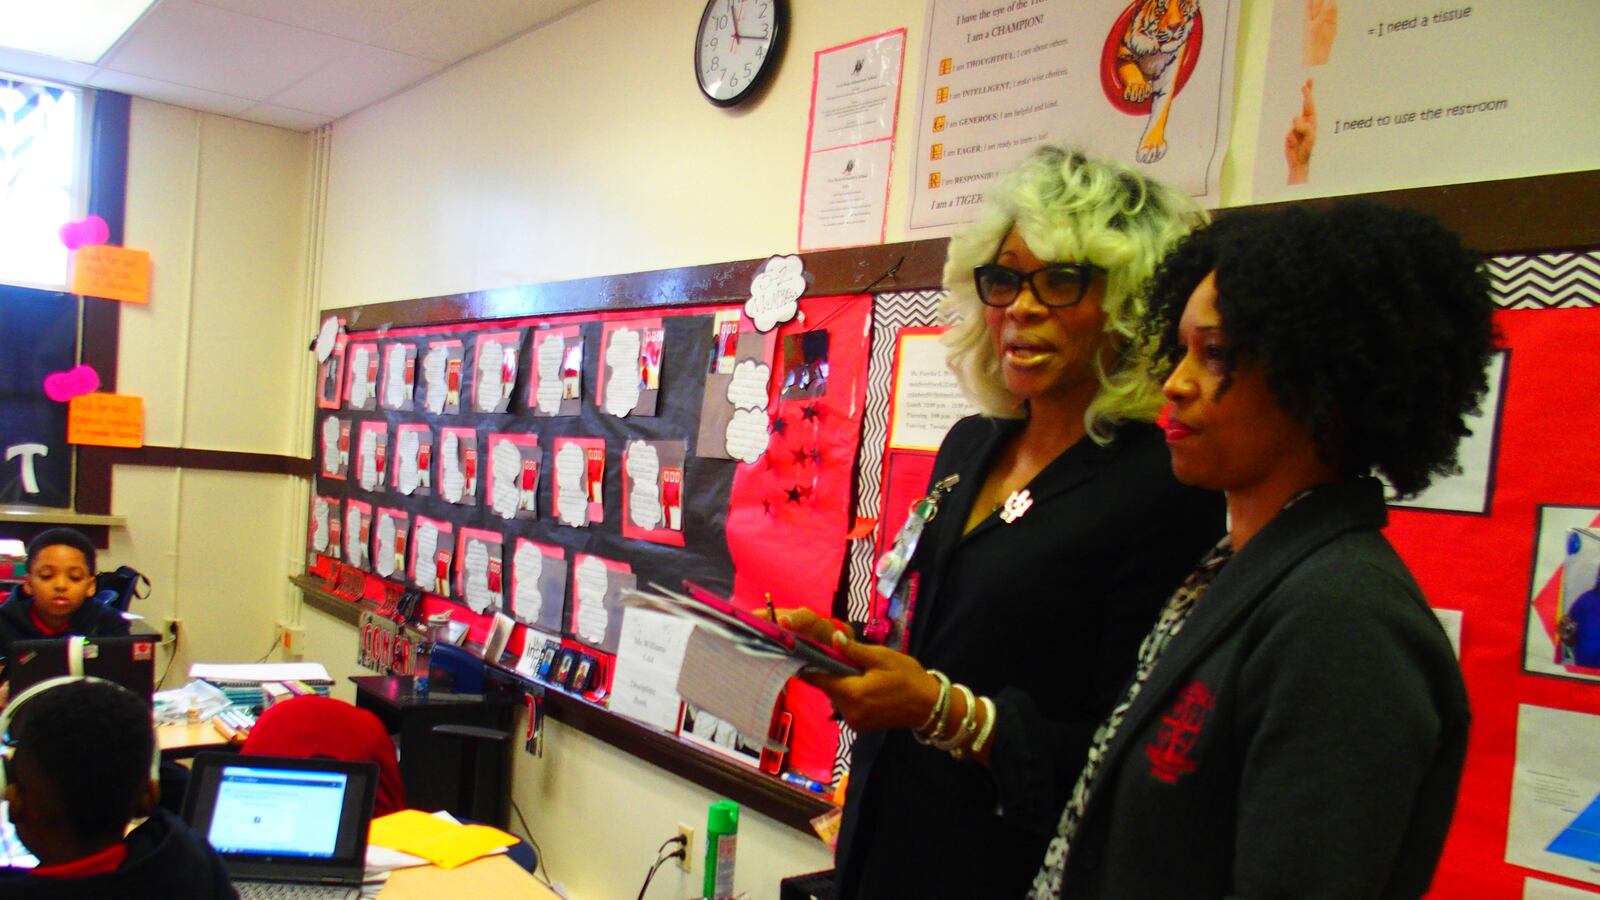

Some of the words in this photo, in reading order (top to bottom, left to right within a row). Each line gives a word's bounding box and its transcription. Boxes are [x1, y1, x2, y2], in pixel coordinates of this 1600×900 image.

[758, 3, 768, 20] 2
[961, 13, 977, 25] have
[979, 9, 991, 20] the
[992, 6, 1005, 18] eye
[1007, 0, 1017, 12] of
[1016, 0, 1028, 10] the
[712, 14, 728, 32] 10
[1378, 22, 1385, 37] I
[1386, 17, 1417, 34] need
[1421, 17, 1429, 27] a
[1432, 6, 1474, 26] tissue
[710, 37, 719, 52] 9
[971, 31, 984, 42] am
[755, 46, 763, 60] 4
[710, 56, 720, 72] 8
[743, 63, 753, 79] 5
[720, 68, 728, 81] 7
[729, 72, 739, 88] 6
[1333, 120, 1341, 134] I
[1342, 117, 1373, 132] need
[1377, 113, 1392, 126] to
[1395, 112, 1417, 126] use
[1420, 107, 1443, 122] the
[1445, 98, 1509, 118] restroom
[936, 200, 947, 209] am
[6, 443, 48, 494] T
